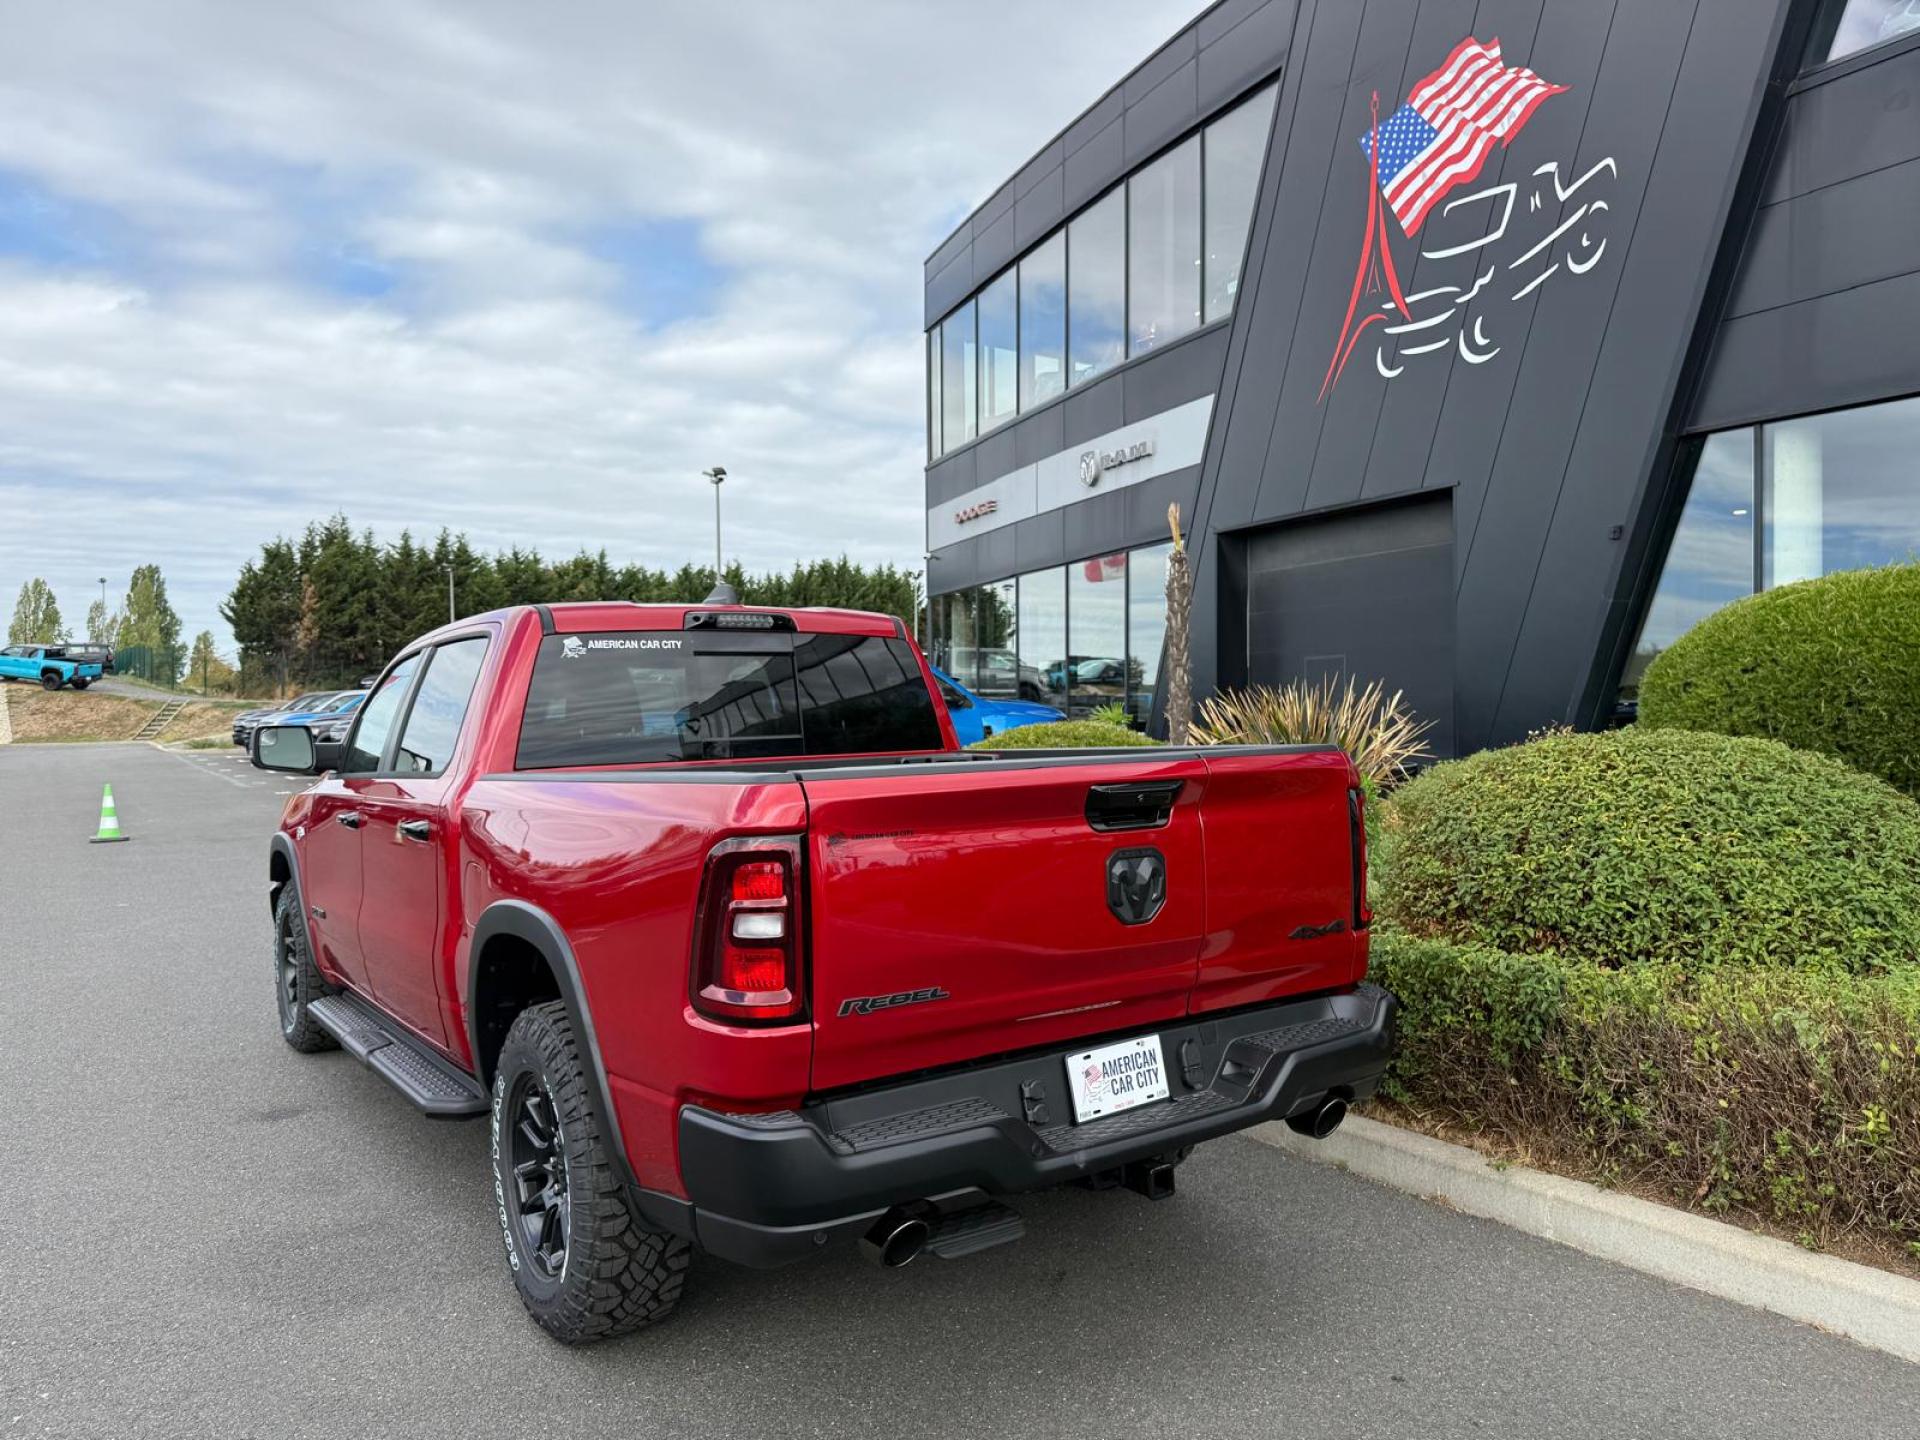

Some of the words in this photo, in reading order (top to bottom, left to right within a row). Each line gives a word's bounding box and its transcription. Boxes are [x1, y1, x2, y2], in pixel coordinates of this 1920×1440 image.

[1100, 440, 1153, 471] RAM
[955, 500, 997, 524] DODGE
[588, 640, 638, 649] AMERICAN
[640, 640, 660, 649] CAR
[661, 640, 682, 649] CITY
[837, 986, 950, 1017] REBEL
[1102, 1048, 1158, 1080] AMERICAN
[1110, 1074, 1135, 1096] CAR
[1136, 1067, 1159, 1089] CITY
